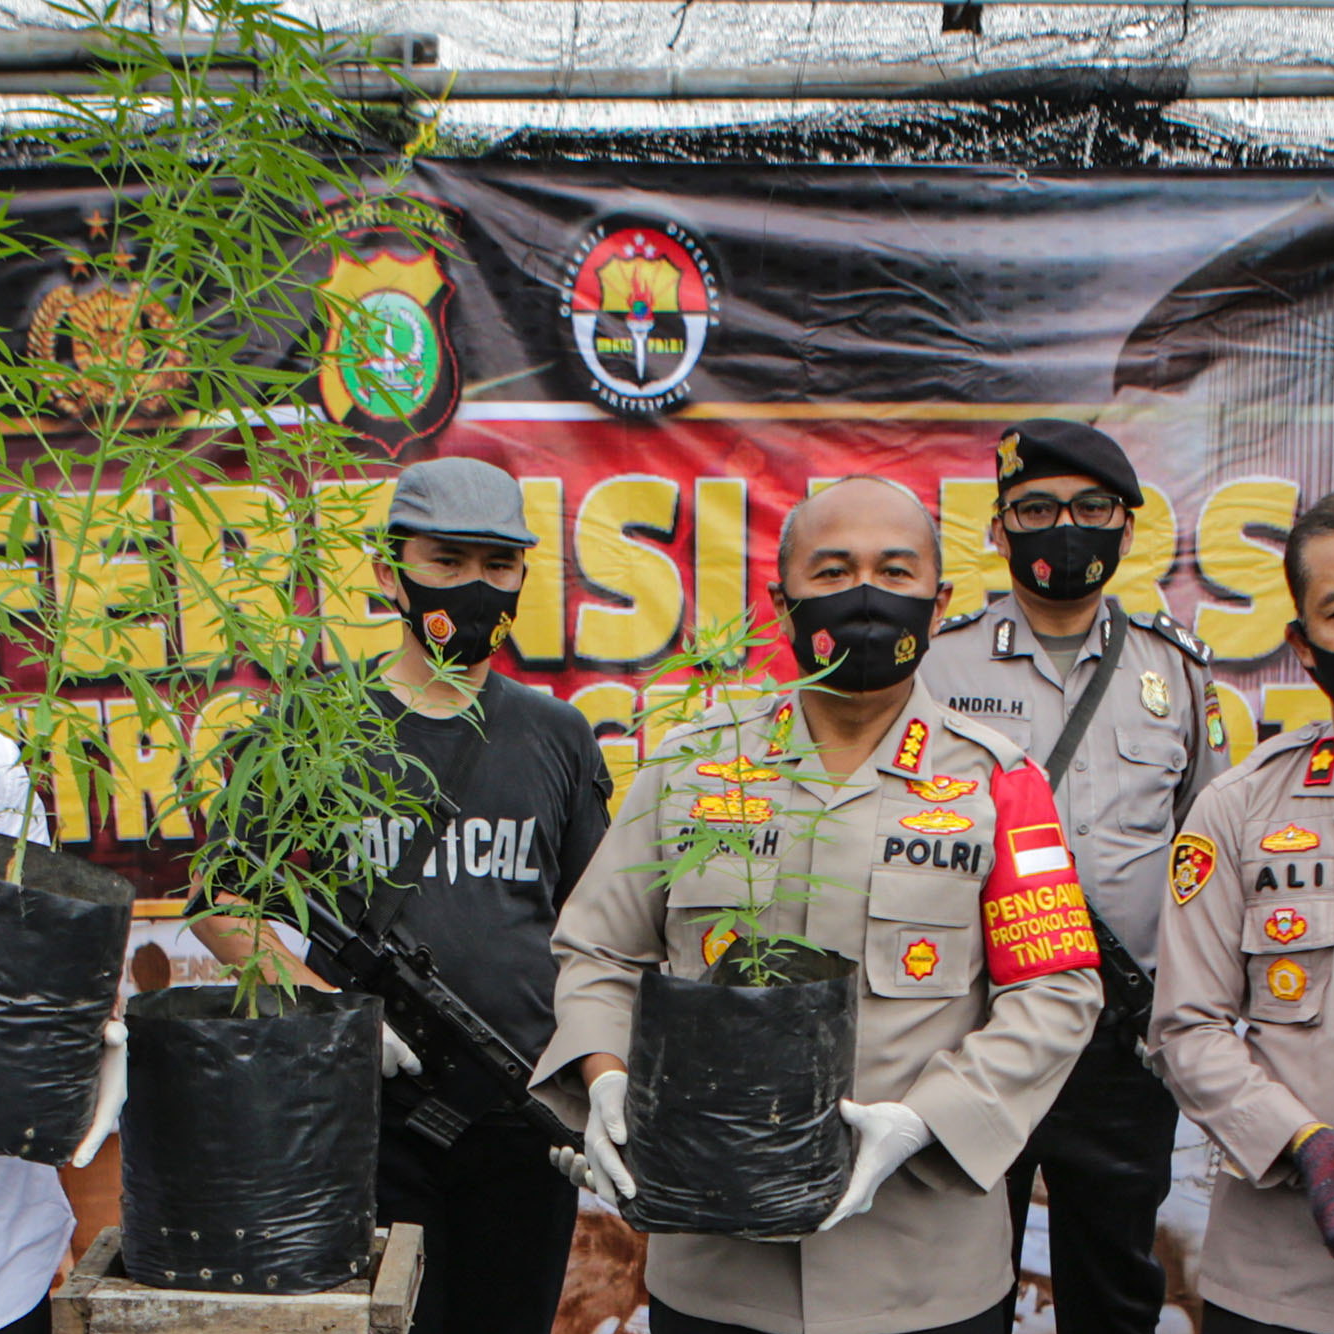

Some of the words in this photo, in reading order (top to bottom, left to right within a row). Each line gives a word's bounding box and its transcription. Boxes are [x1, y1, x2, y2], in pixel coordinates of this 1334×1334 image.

[883, 836, 983, 874] POLRI
[1255, 861, 1324, 893] ALI
[990, 913, 1069, 948] PROTOKOL
